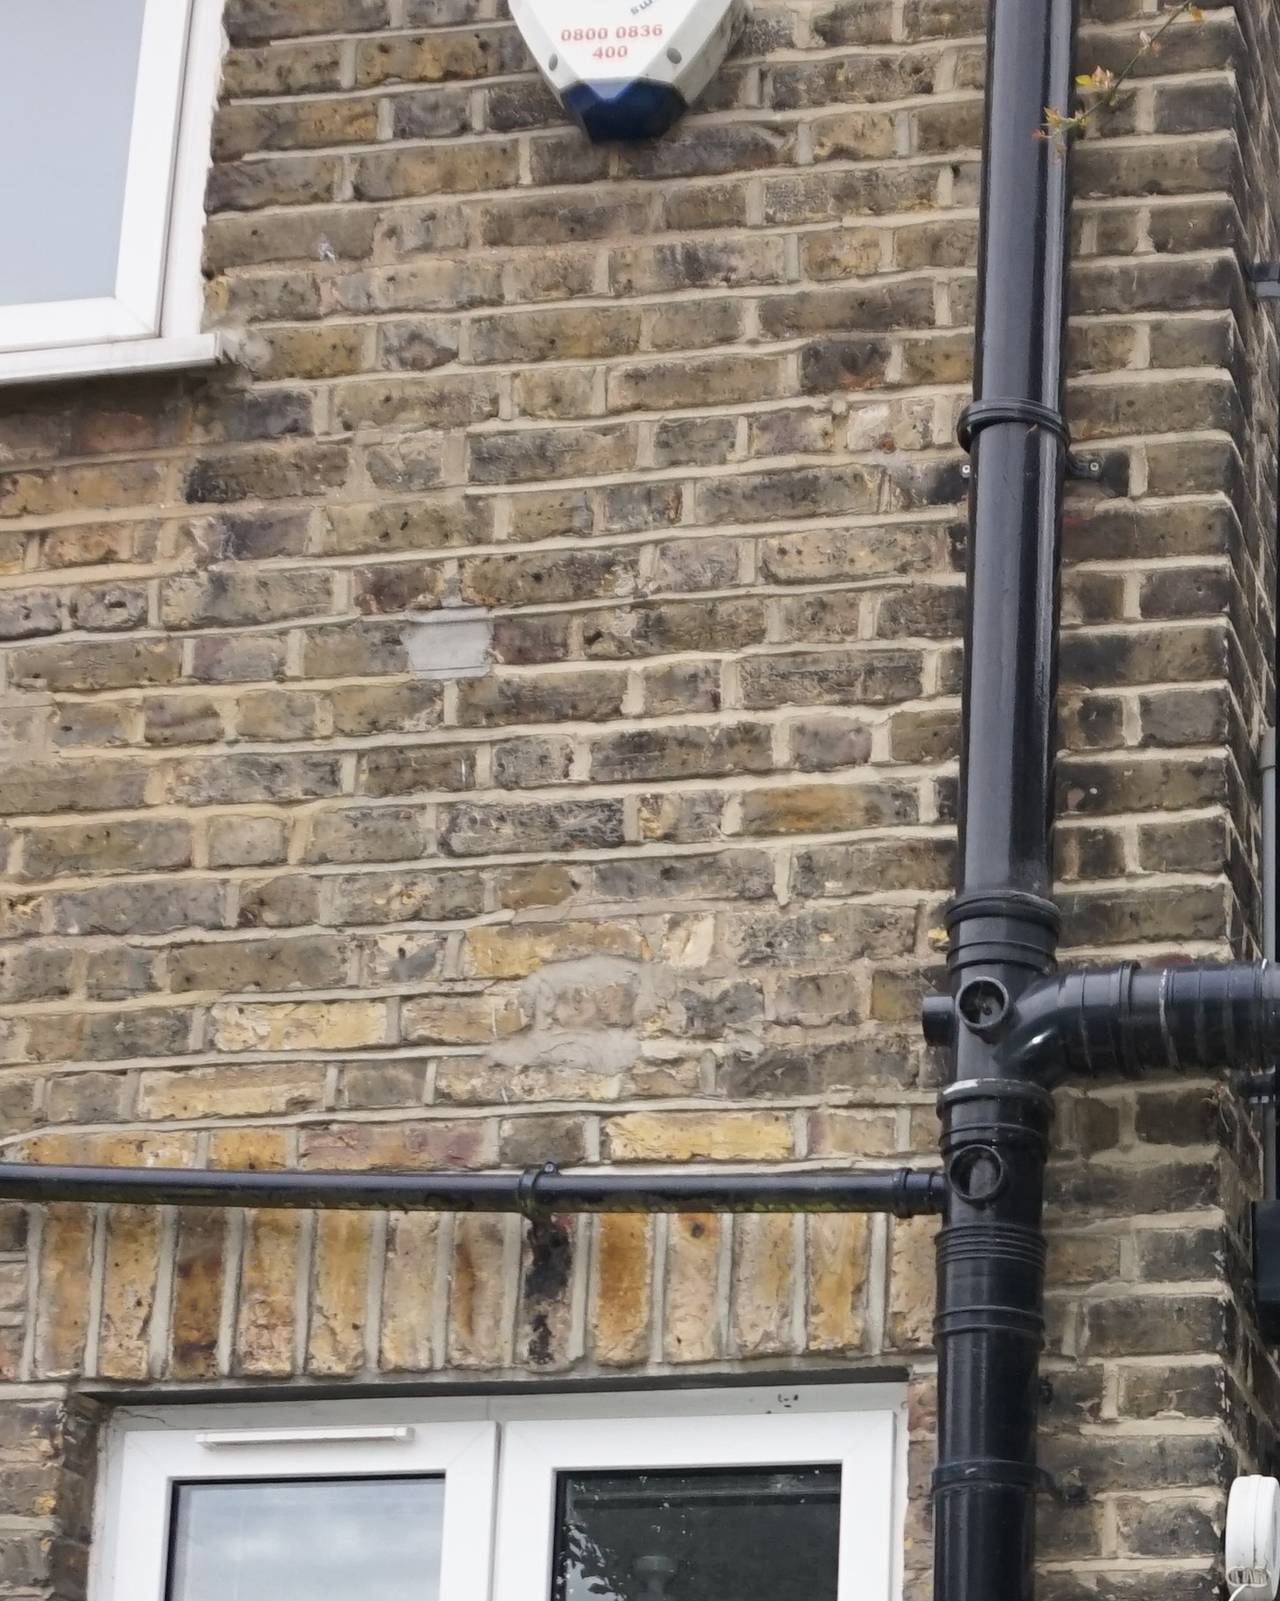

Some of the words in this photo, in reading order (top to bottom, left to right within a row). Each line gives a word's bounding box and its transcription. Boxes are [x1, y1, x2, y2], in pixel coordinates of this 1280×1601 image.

[561, 28, 608, 41] 0800
[616, 24, 663, 39] 0836
[592, 46, 628, 59] 400
